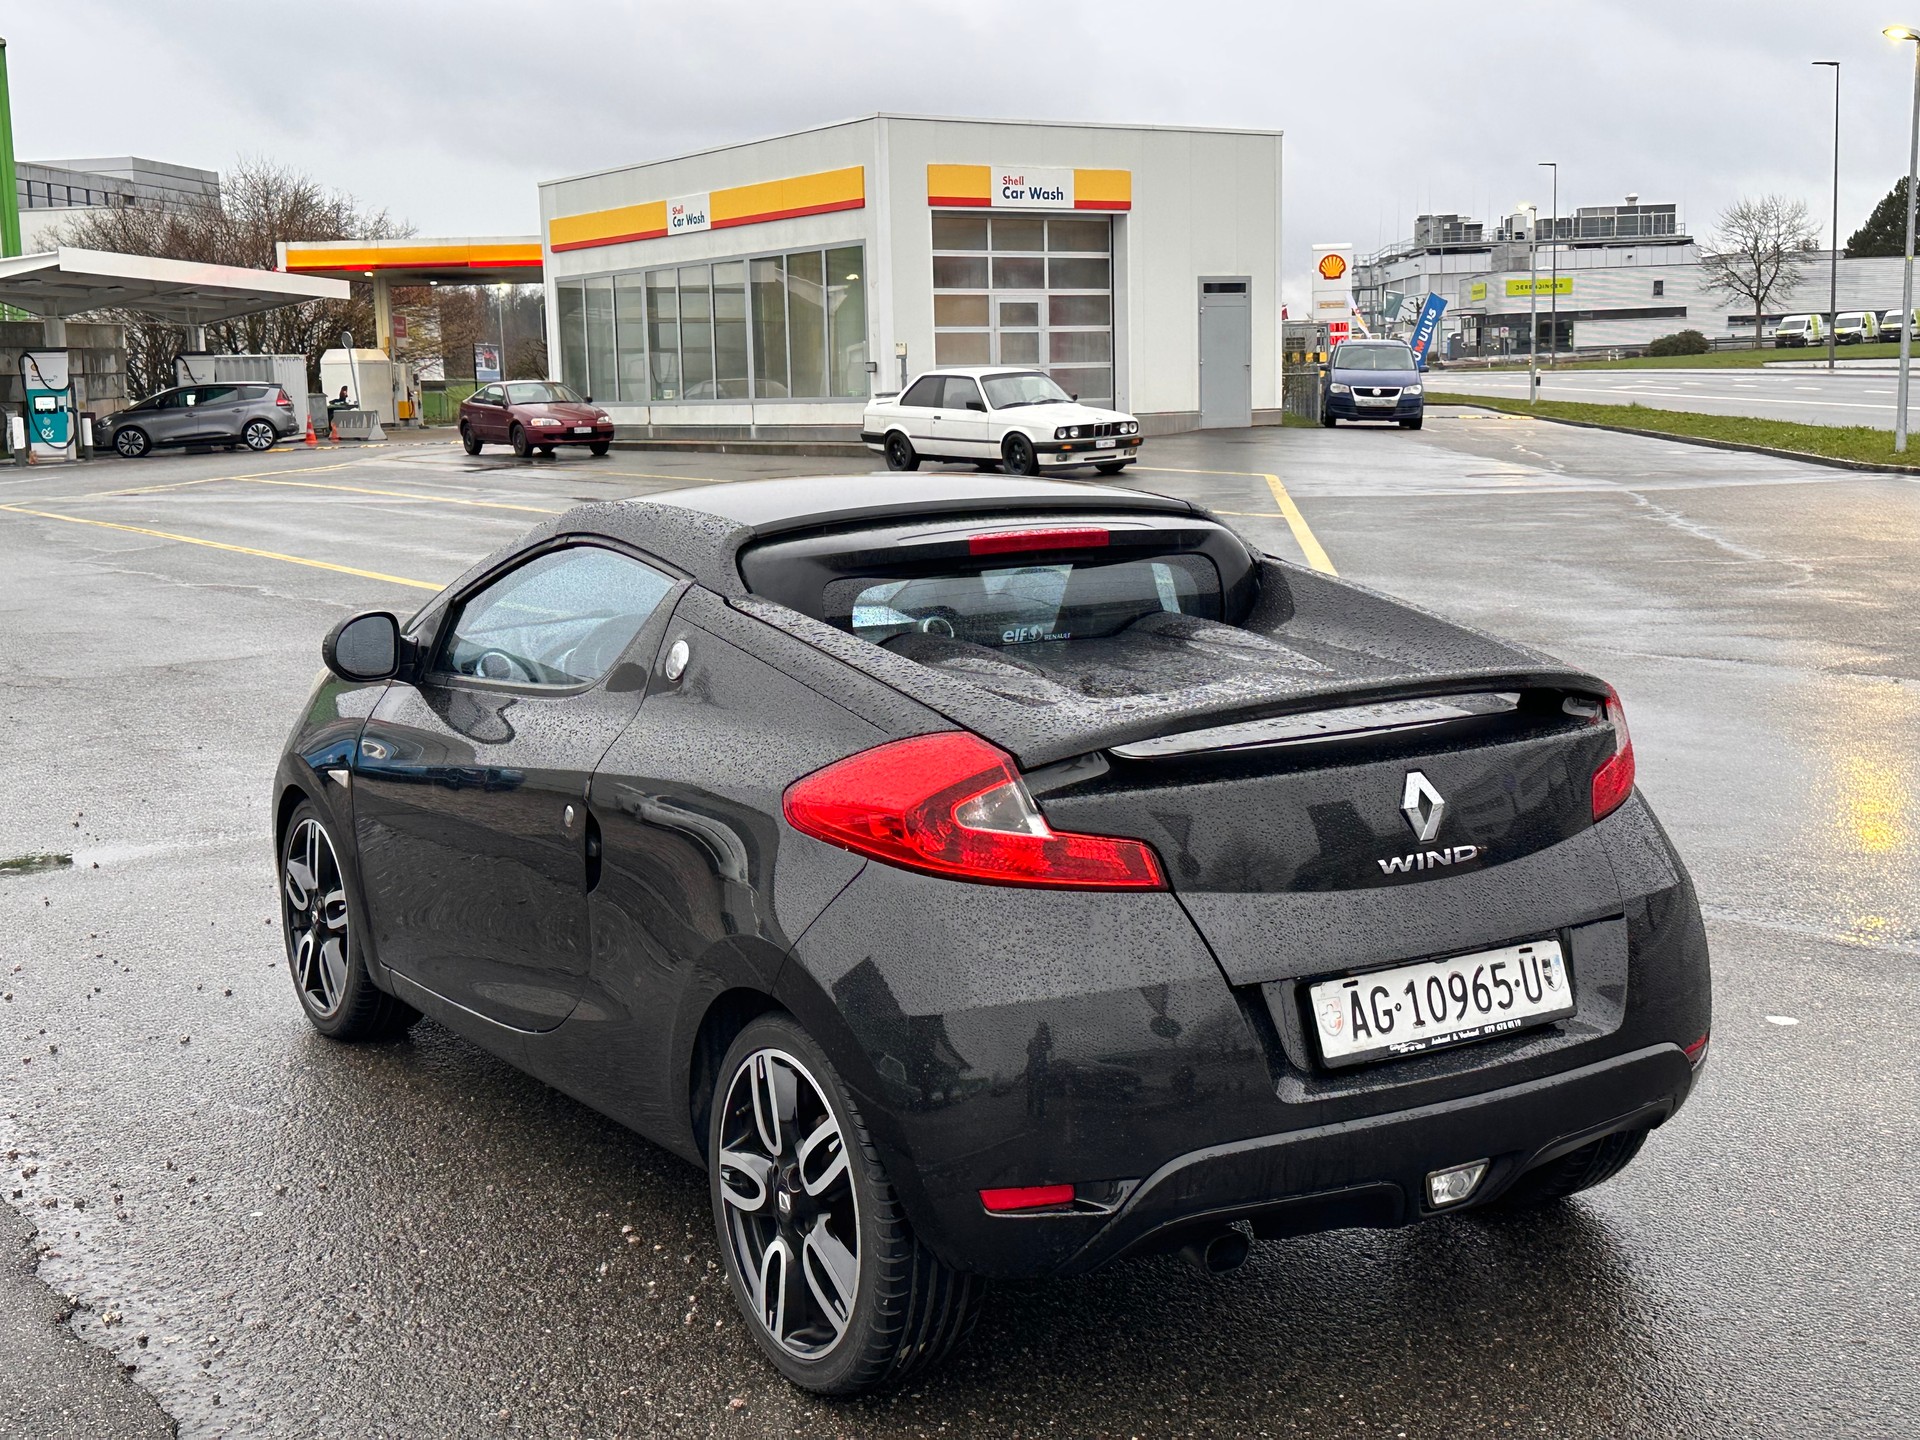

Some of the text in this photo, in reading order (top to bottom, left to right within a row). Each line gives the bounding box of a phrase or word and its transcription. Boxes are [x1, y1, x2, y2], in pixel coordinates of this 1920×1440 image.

[1002, 175, 1024, 186] Shell
[1002, 186, 1064, 201] Car Wash
[672, 204, 684, 216] Shell
[672, 210, 705, 228] Car Wash
[1002, 627, 1028, 643] elf
[1377, 844, 1478, 875] WIND
